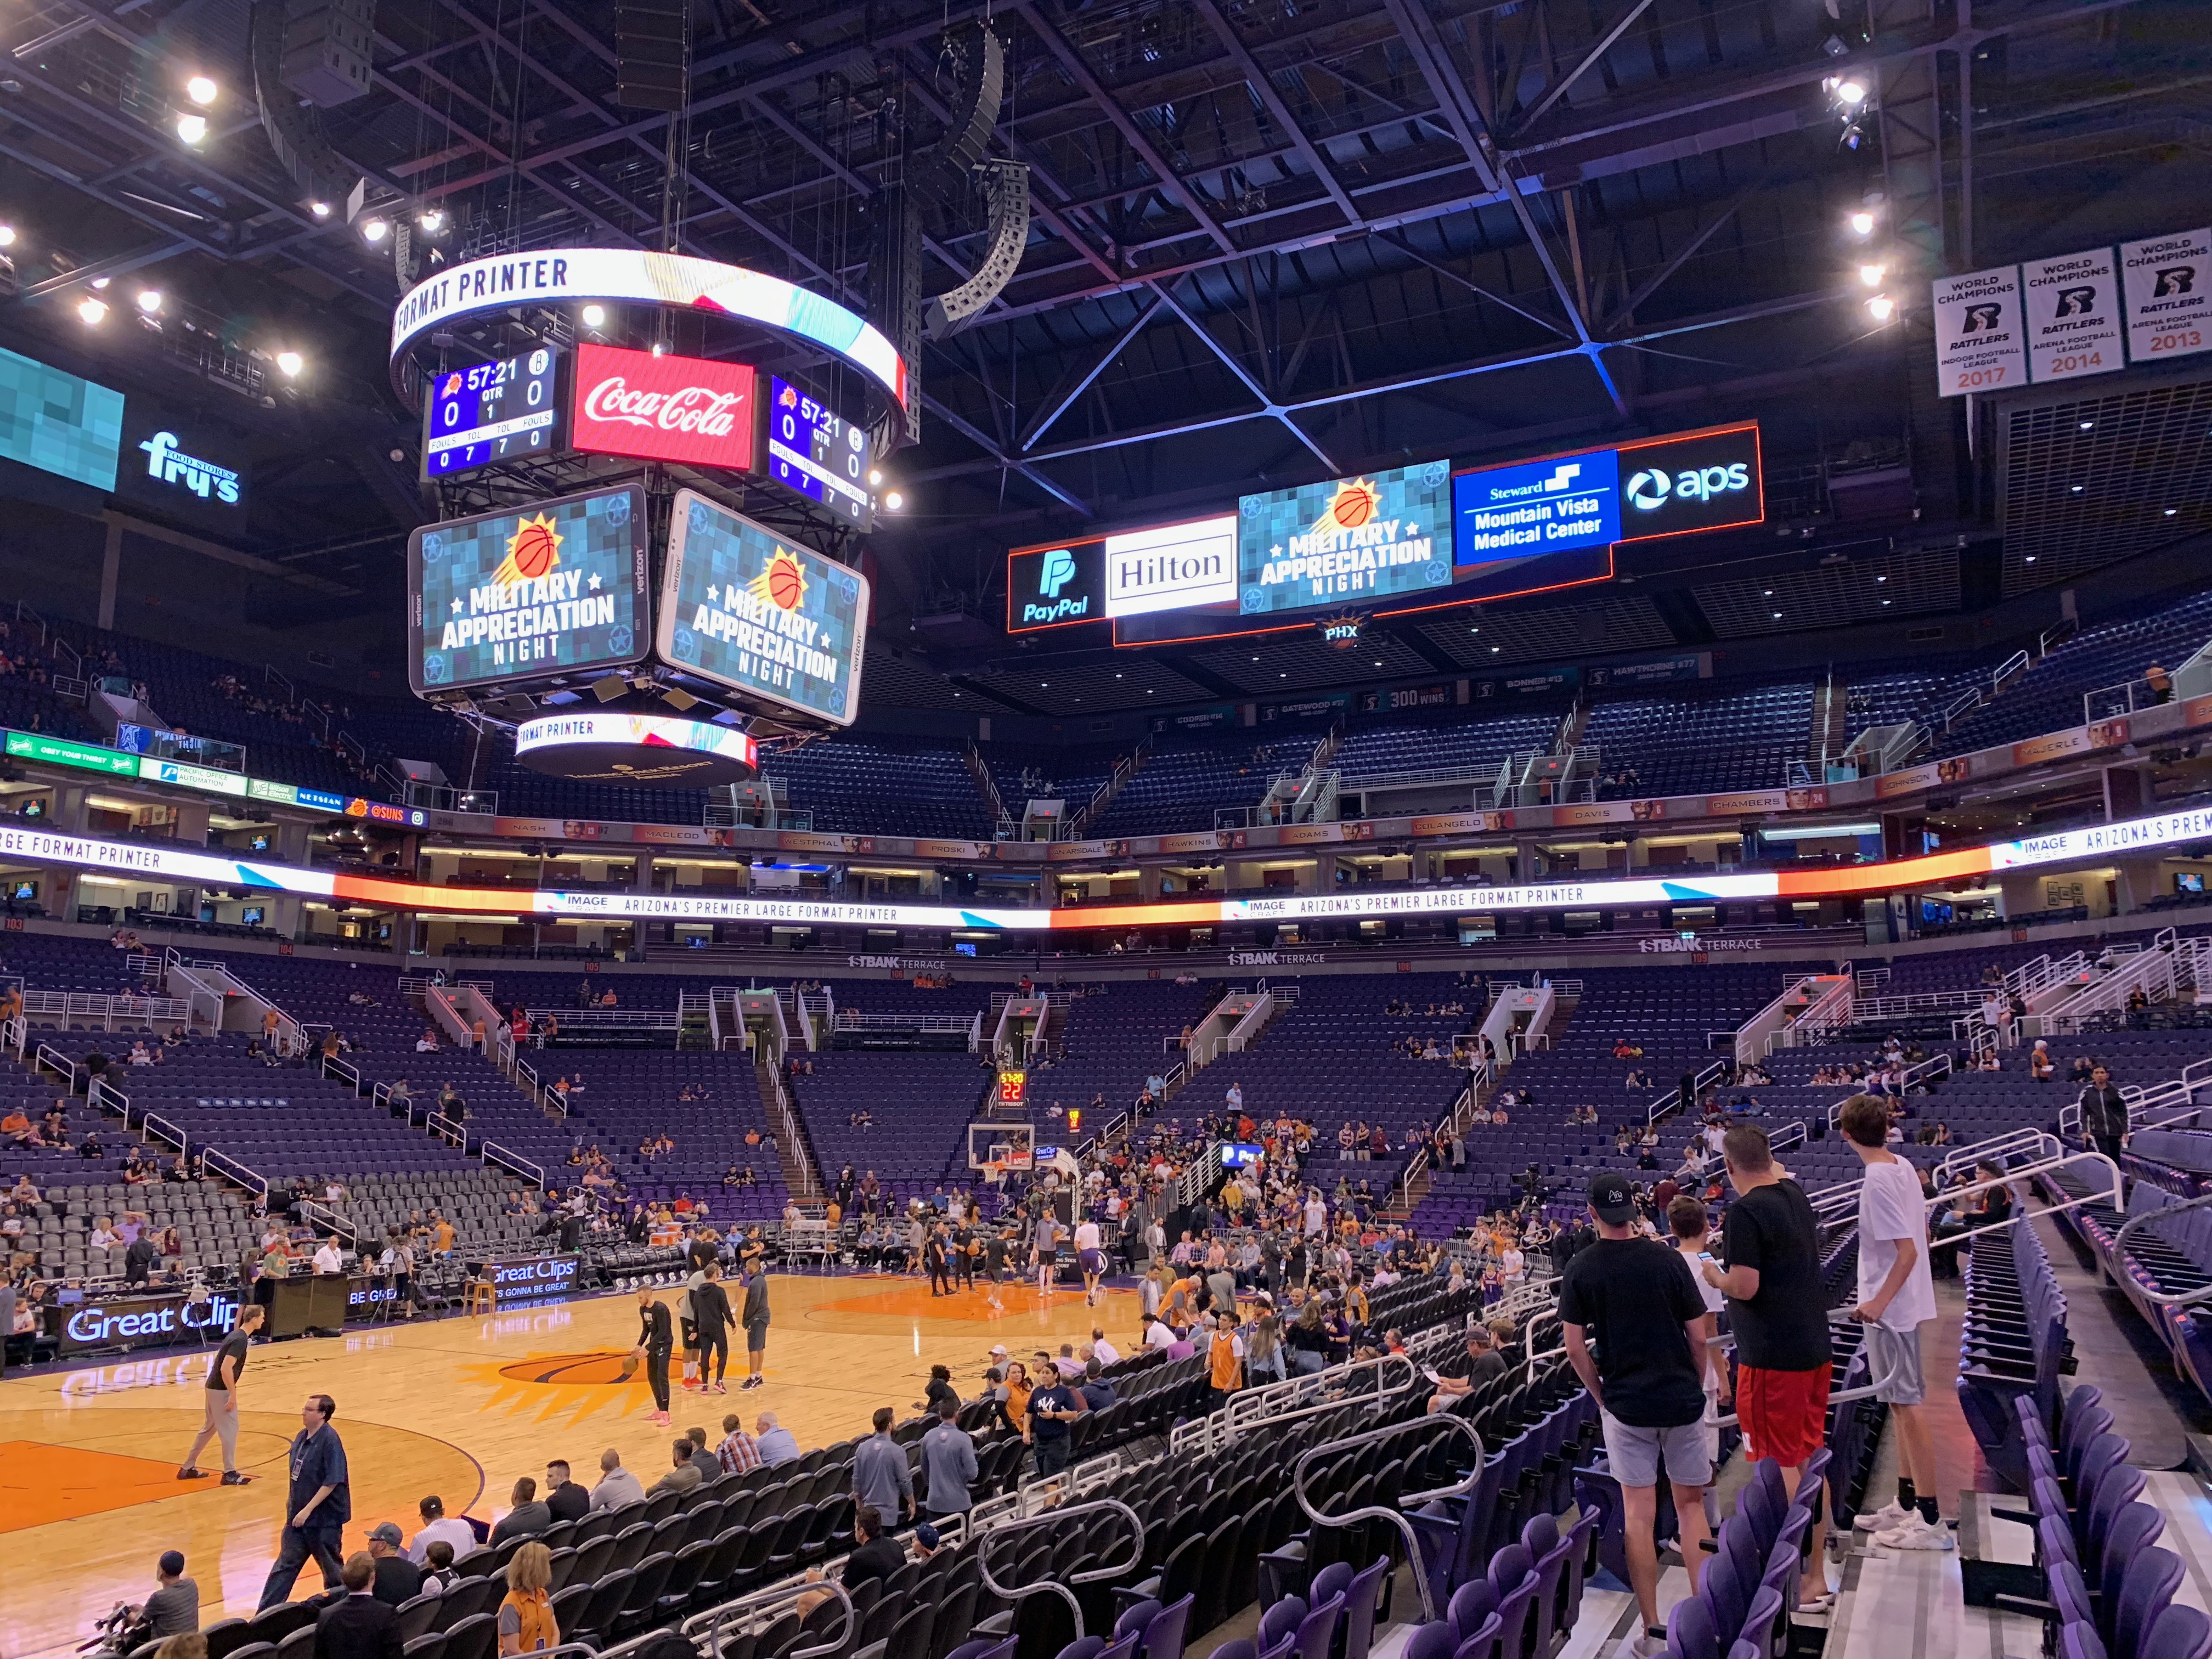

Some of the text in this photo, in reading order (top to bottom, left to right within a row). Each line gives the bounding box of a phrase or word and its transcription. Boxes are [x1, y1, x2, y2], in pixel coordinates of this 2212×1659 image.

[2141, 239, 2192, 255] WORLD
[2042, 259, 2092, 274] WORLD
[2126, 246, 2208, 268] CHAMPIONS
[1951, 276, 1999, 291] WORLD
[2029, 266, 2109, 287] CHAMPIONS
[398, 259, 567, 338] FORMAT PRINTER
[1938, 283, 2014, 304] CHAMPIONS
[2140, 296, 2205, 314] RATTLERS
[2042, 317, 2105, 335] RATTLERS
[2132, 319, 2165, 330] ARENA
[2155, 321, 2193, 332] LEAGUE
[1950, 332, 2010, 351] RATTLERS
[2033, 331, 2117, 351] ARENA FOOTBALL
[2057, 341, 2093, 353] LEAGUE
[2151, 330, 2202, 352] 2013
[1941, 348, 2021, 366] INDOOR FOOTBALL
[1963, 358, 1999, 369] LEAGUE
[2052, 352, 2102, 373] 2014
[467, 358, 517, 390] 57:21
[1958, 366, 2006, 388] 2017
[482, 386, 503, 402] QTR
[527, 380, 541, 405] 0
[444, 402, 459, 426] 0
[487, 404, 493, 419] 1
[585, 377, 743, 437] Coca-Cola
[783, 414, 794, 439] 0
[801, 397, 840, 438] 57:21
[432, 414, 549, 449] FOULS TOL TOL FOULS
[814, 428, 830, 447] QTR
[441, 431, 539, 467] 0 7 7 0
[818, 447, 822, 460] 1
[139, 431, 240, 503] fry's
[166, 450, 233, 479] FOOD STORES
[772, 443, 865, 501] FOULS TOL TOL FOULS
[848, 454, 859, 478] 0
[781, 462, 858, 517] 0 7 7 0
[1490, 481, 1543, 501] Steward
[1677, 462, 1749, 501] aps
[1475, 497, 1599, 530] Mountain Vista
[1289, 519, 1400, 560] MILITARY
[1475, 519, 1601, 550] Medical Center
[1120, 551, 1222, 589] Hilton
[1261, 538, 1431, 586] APPRECIATION
[673, 558, 682, 592] verizon
[1312, 570, 1378, 596] NIGHT
[470, 569, 582, 616] MILITARY
[724, 584, 818, 646] MILITARY
[1024, 596, 1088, 623] PayPal
[441, 594, 614, 650] APPRECIATION
[1325, 625, 1358, 641] PHX
[494, 634, 559, 665] NIGHT
[692, 604, 837, 683] APPRECIATION
[854, 634, 862, 672] verizon
[738, 651, 794, 690] NIGHT
[1614, 662, 1676, 675] HAWTHORNE
[1282, 702, 1330, 712] GATEWOOD
[1391, 690, 1418, 707] 300
[1420, 693, 1444, 704] WINS
[520, 721, 594, 744] FORMAT PRINTER
[41, 747, 107, 764] OBEY YOUR THIRST
[2022, 737, 2080, 758] MAJERLE
[179, 774, 224, 787] AUTOMATION
[180, 766, 228, 781] PACIFIC OFFICE
[1883, 772, 1930, 791] JOHNSON
[268, 791, 292, 801] Electric
[269, 784, 289, 793] Wilson
[1713, 793, 1823, 809] CHAMBERS 24
[371, 804, 403, 822] @SUNS
[1576, 804, 1662, 819] DAVIS 6
[588, 826, 595, 835] 13
[1415, 819, 1480, 830] COLANGELO
[645, 830, 699, 840] MACLEOD
[784, 837, 871, 849] WESTPHAL 44
[1167, 835, 1244, 848] HAWKINS 42
[1292, 830, 1329, 839] ADAMS
[2024, 822, 2164, 854] IMAGE ARIZONA'S
[33, 837, 160, 868] FORMAT PRINTER
[932, 845, 966, 854] PROSKI
[1065, 847, 1102, 855] ARSDALE
[1121, 844, 1127, 852] 5
[567, 895, 897, 921] IMAGE ARIZONA'S PREMIER LARGE FORMAT PRINTER
[1250, 888, 1584, 913] IMAGE ARIZONA'S PREMIER LARGE FORMAT PRINTER
[6, 918, 22, 930] 103
[280, 944, 292, 955] 104
[1638, 938, 1762, 953] 1STBANK TERRACE
[586, 962, 599, 972] 105
[848, 955, 945, 970] 1STBANK TERRACE
[1227, 952, 1325, 966] 1STBANK TERRACE
[1692, 953, 1708, 964] 109
[891, 970, 904, 979] 106
[1149, 969, 1160, 978] 107
[1001, 1073, 1023, 1084] 57:20
[1003, 1083, 1020, 1099] 22
[537, 1260, 574, 1281] Clips
[349, 1291, 365, 1305] BE
[506, 1282, 567, 1296] GONNA BE GREAT
[68, 1307, 174, 1342] Great
